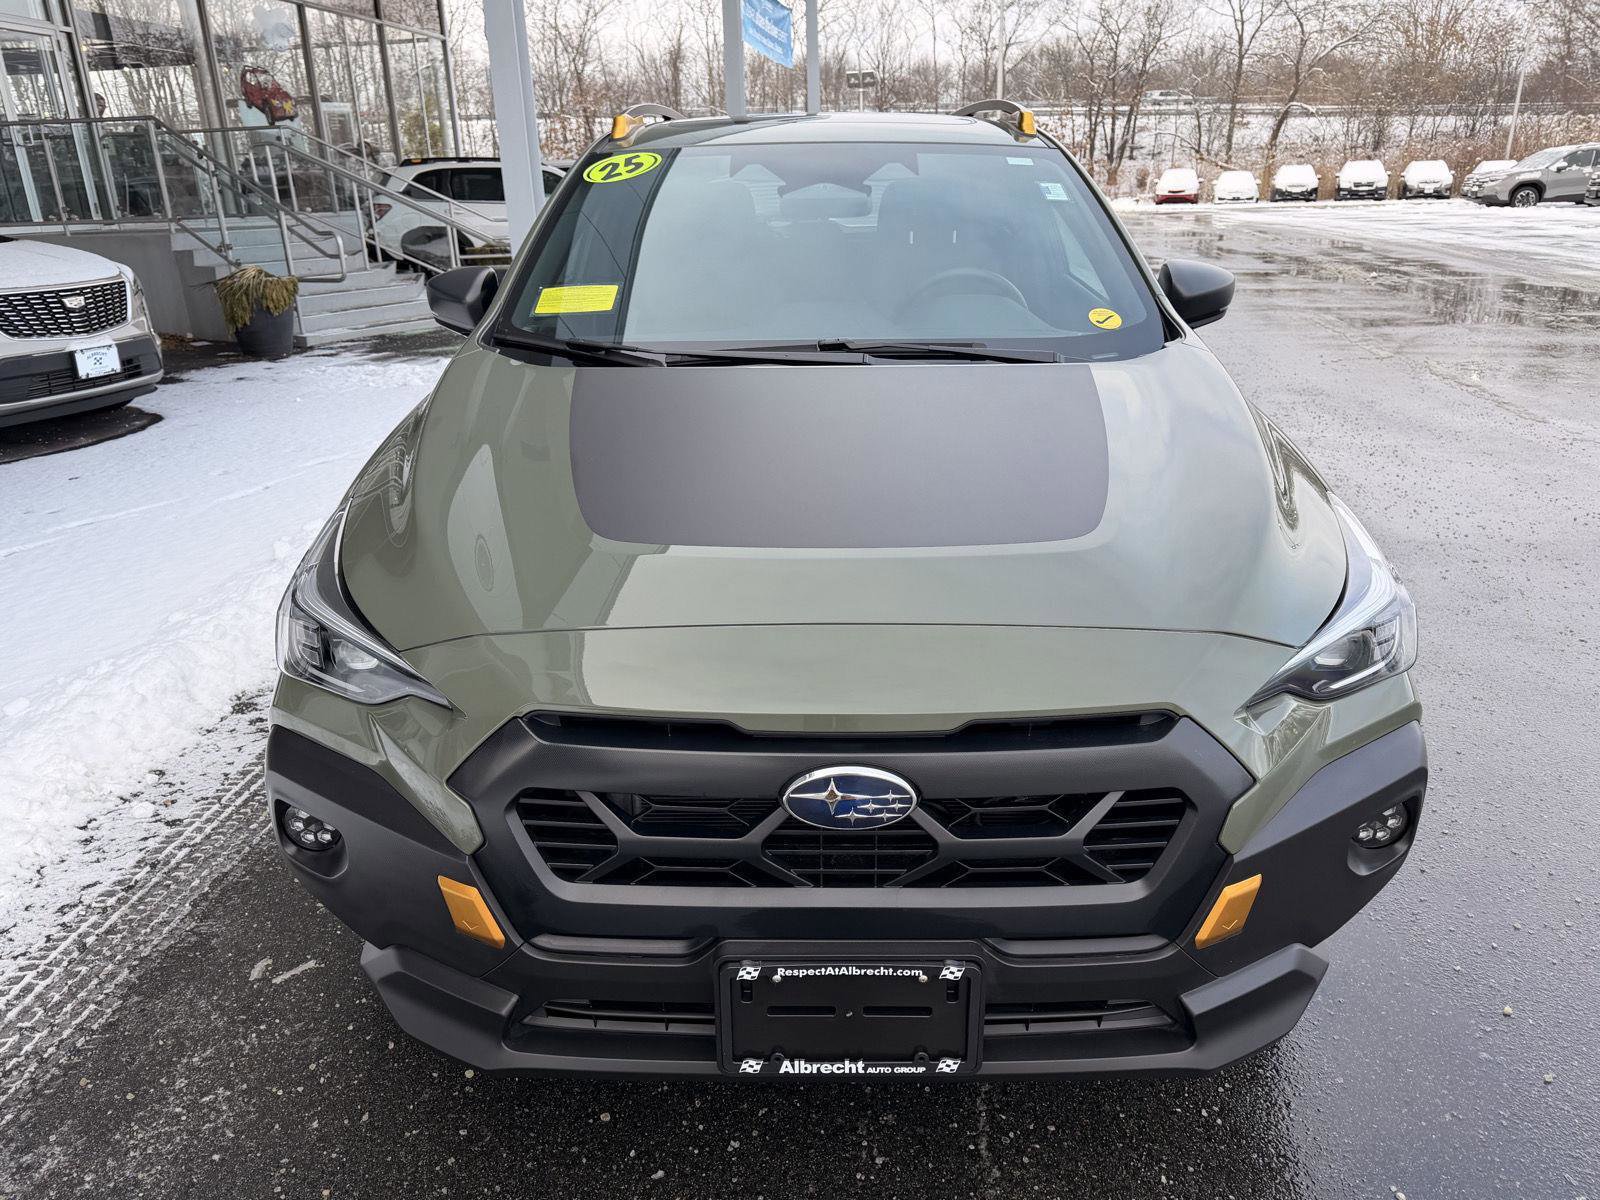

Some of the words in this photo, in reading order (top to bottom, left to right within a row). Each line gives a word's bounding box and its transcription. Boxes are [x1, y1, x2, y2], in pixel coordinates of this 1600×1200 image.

[599, 154, 644, 181] 25
[777, 966, 923, 977] RespectAtAlbrecht.com
[779, 1059, 865, 1074] Albrecht
[893, 1066, 926, 1074] GROUP
